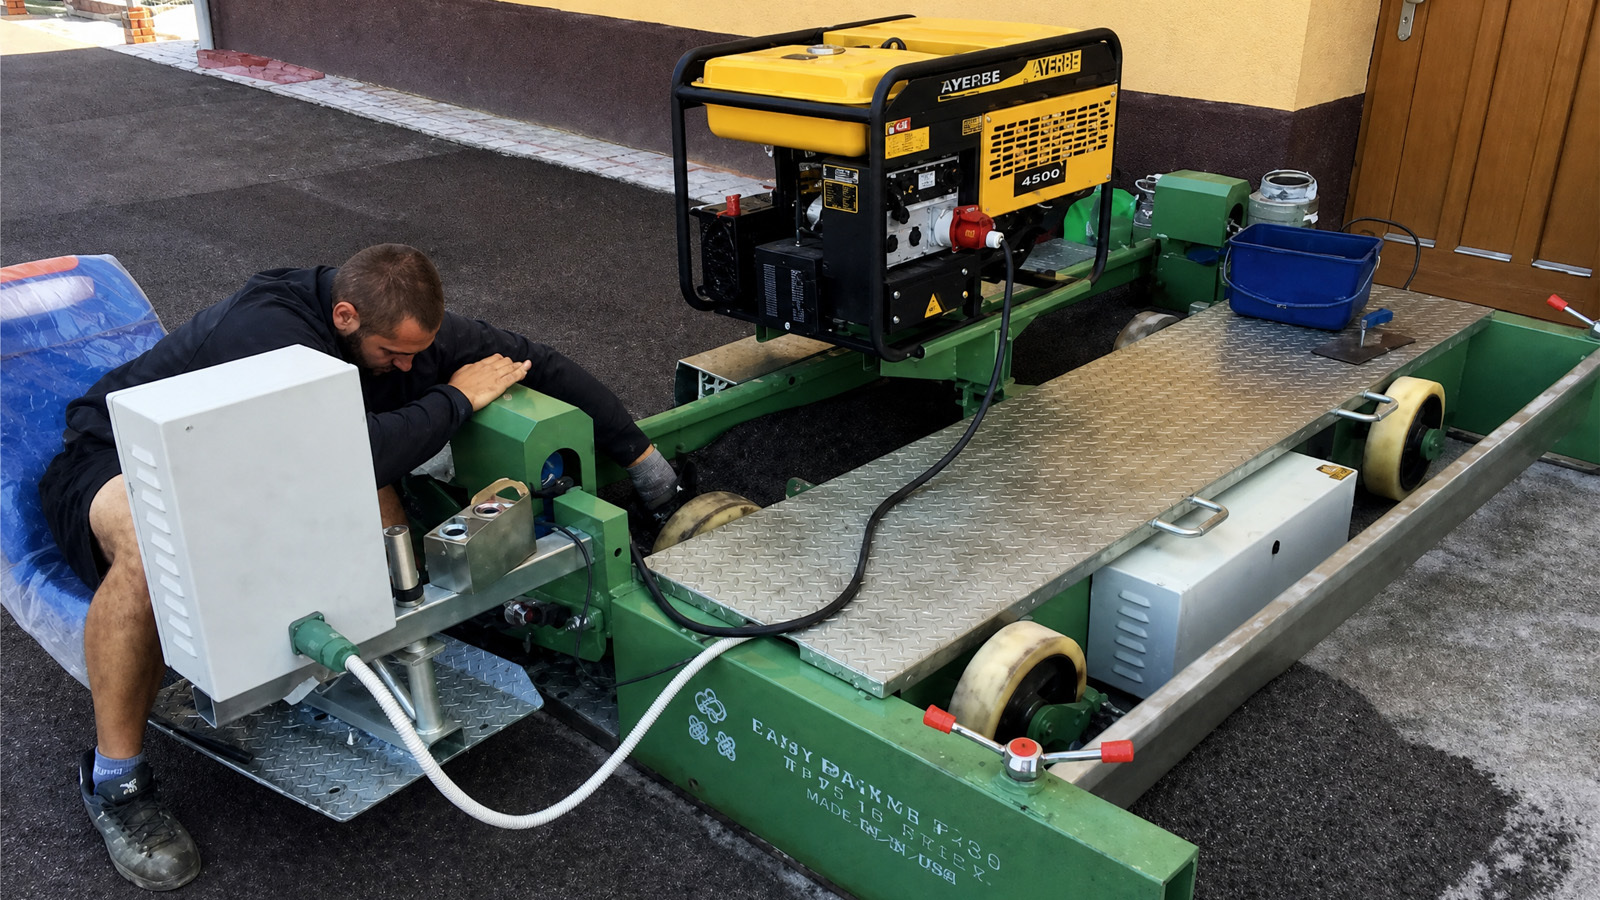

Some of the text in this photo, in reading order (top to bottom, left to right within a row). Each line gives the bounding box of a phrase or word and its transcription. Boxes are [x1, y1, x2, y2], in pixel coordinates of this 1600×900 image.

[1033, 53, 1080, 78] AYERBE
[941, 70, 1000, 93] AYERBE
[1021, 168, 1060, 186] 4500
[806, 788, 851, 823] MADE
